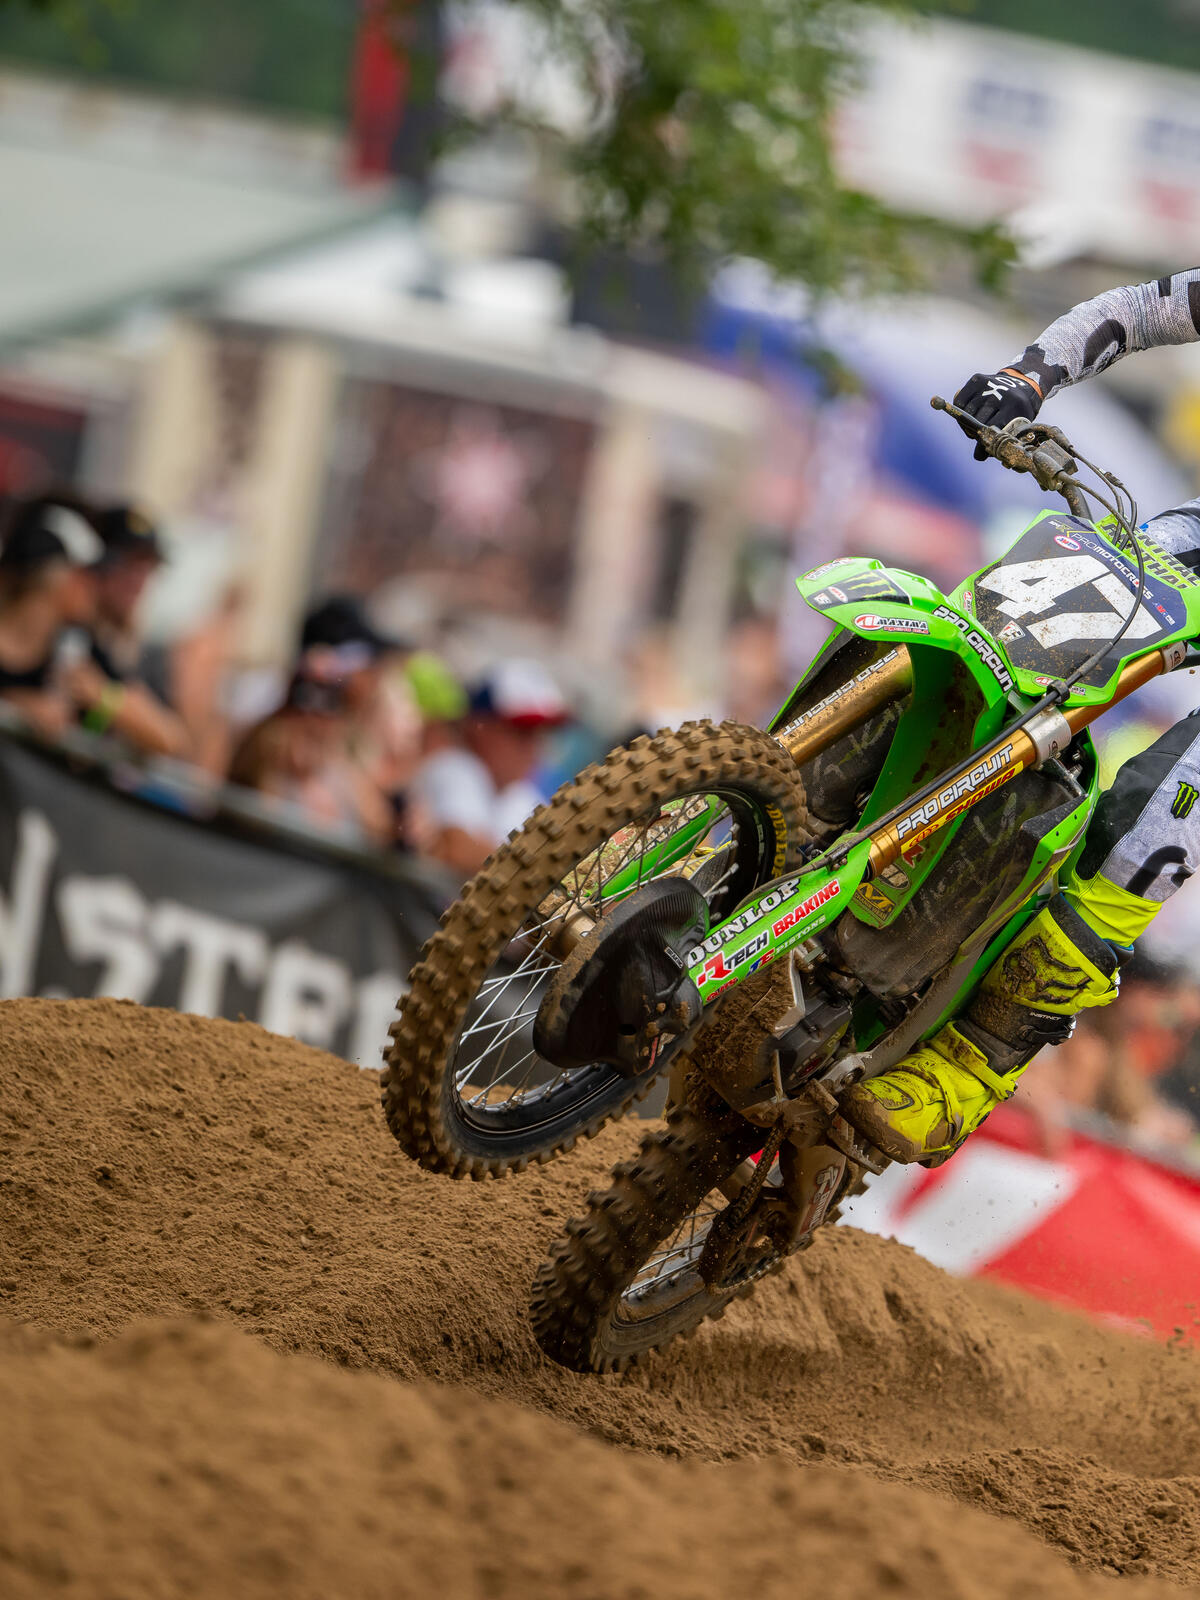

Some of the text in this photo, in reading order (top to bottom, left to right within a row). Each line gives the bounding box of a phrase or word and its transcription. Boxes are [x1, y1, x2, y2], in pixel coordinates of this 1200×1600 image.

[877, 618, 928, 629] MAXIMA
[976, 555, 1163, 650] 47
[933, 605, 971, 633] PRO
[966, 630, 1016, 693] CIRCUIT
[896, 743, 1013, 840] PRO CIRCUIT
[945, 767, 1016, 821] SHOWA
[687, 878, 801, 968] DUNLOP
[772, 878, 841, 939] BRAKING
[776, 914, 827, 953] PISTONS
